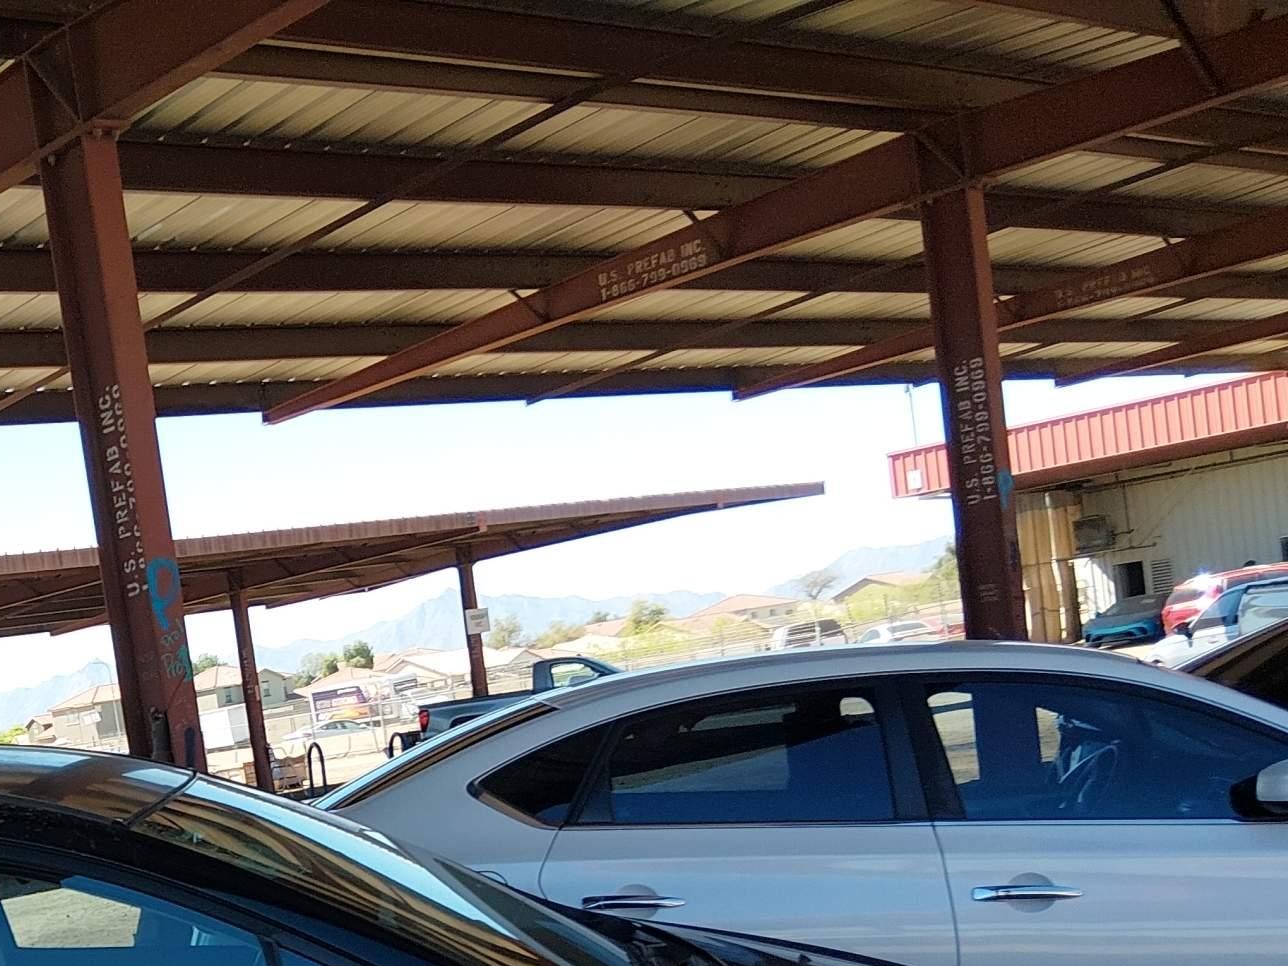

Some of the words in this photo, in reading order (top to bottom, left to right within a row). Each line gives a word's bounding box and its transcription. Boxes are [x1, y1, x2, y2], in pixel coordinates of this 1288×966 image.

[600, 253, 708, 302] 1-866-799-0969
[626, 248, 676, 276] PREFAB
[680, 239, 706, 258] INC.
[954, 358, 971, 393] INC.
[98, 383, 116, 434] INC.
[958, 399, 978, 466] PREFAB
[968, 356, 999, 501] 1-866-799-0969
[105, 444, 133, 539] PREFAB
[965, 473, 980, 506] U.S.
[123, 550, 142, 598] U.S.
